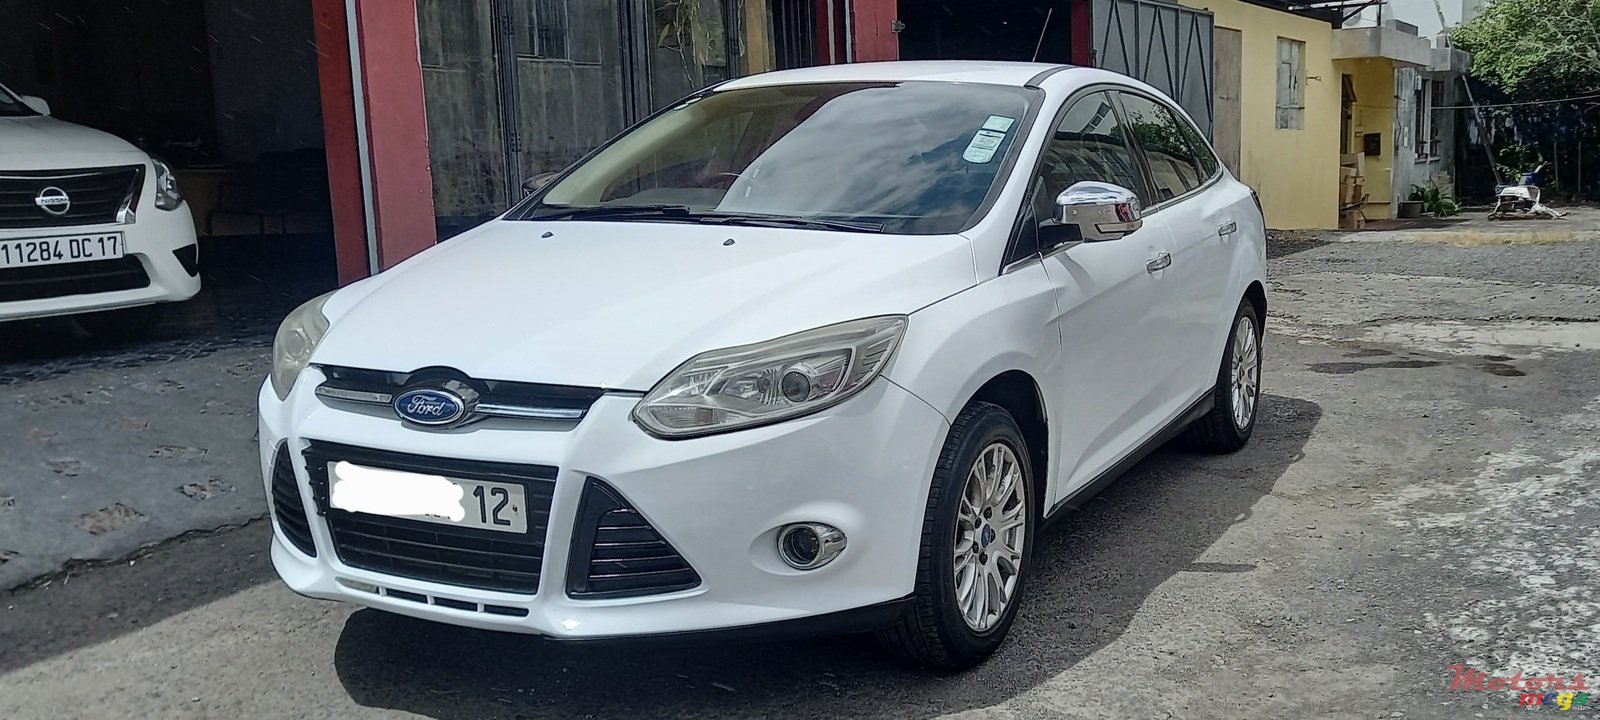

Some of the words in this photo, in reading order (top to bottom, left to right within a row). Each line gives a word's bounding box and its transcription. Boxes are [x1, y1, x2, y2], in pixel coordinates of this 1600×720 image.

[1, 240, 64, 265] 11284
[69, 238, 93, 259] DC
[97, 236, 117, 257] 17
[407, 394, 446, 416] Ford
[472, 485, 511, 526] 12
